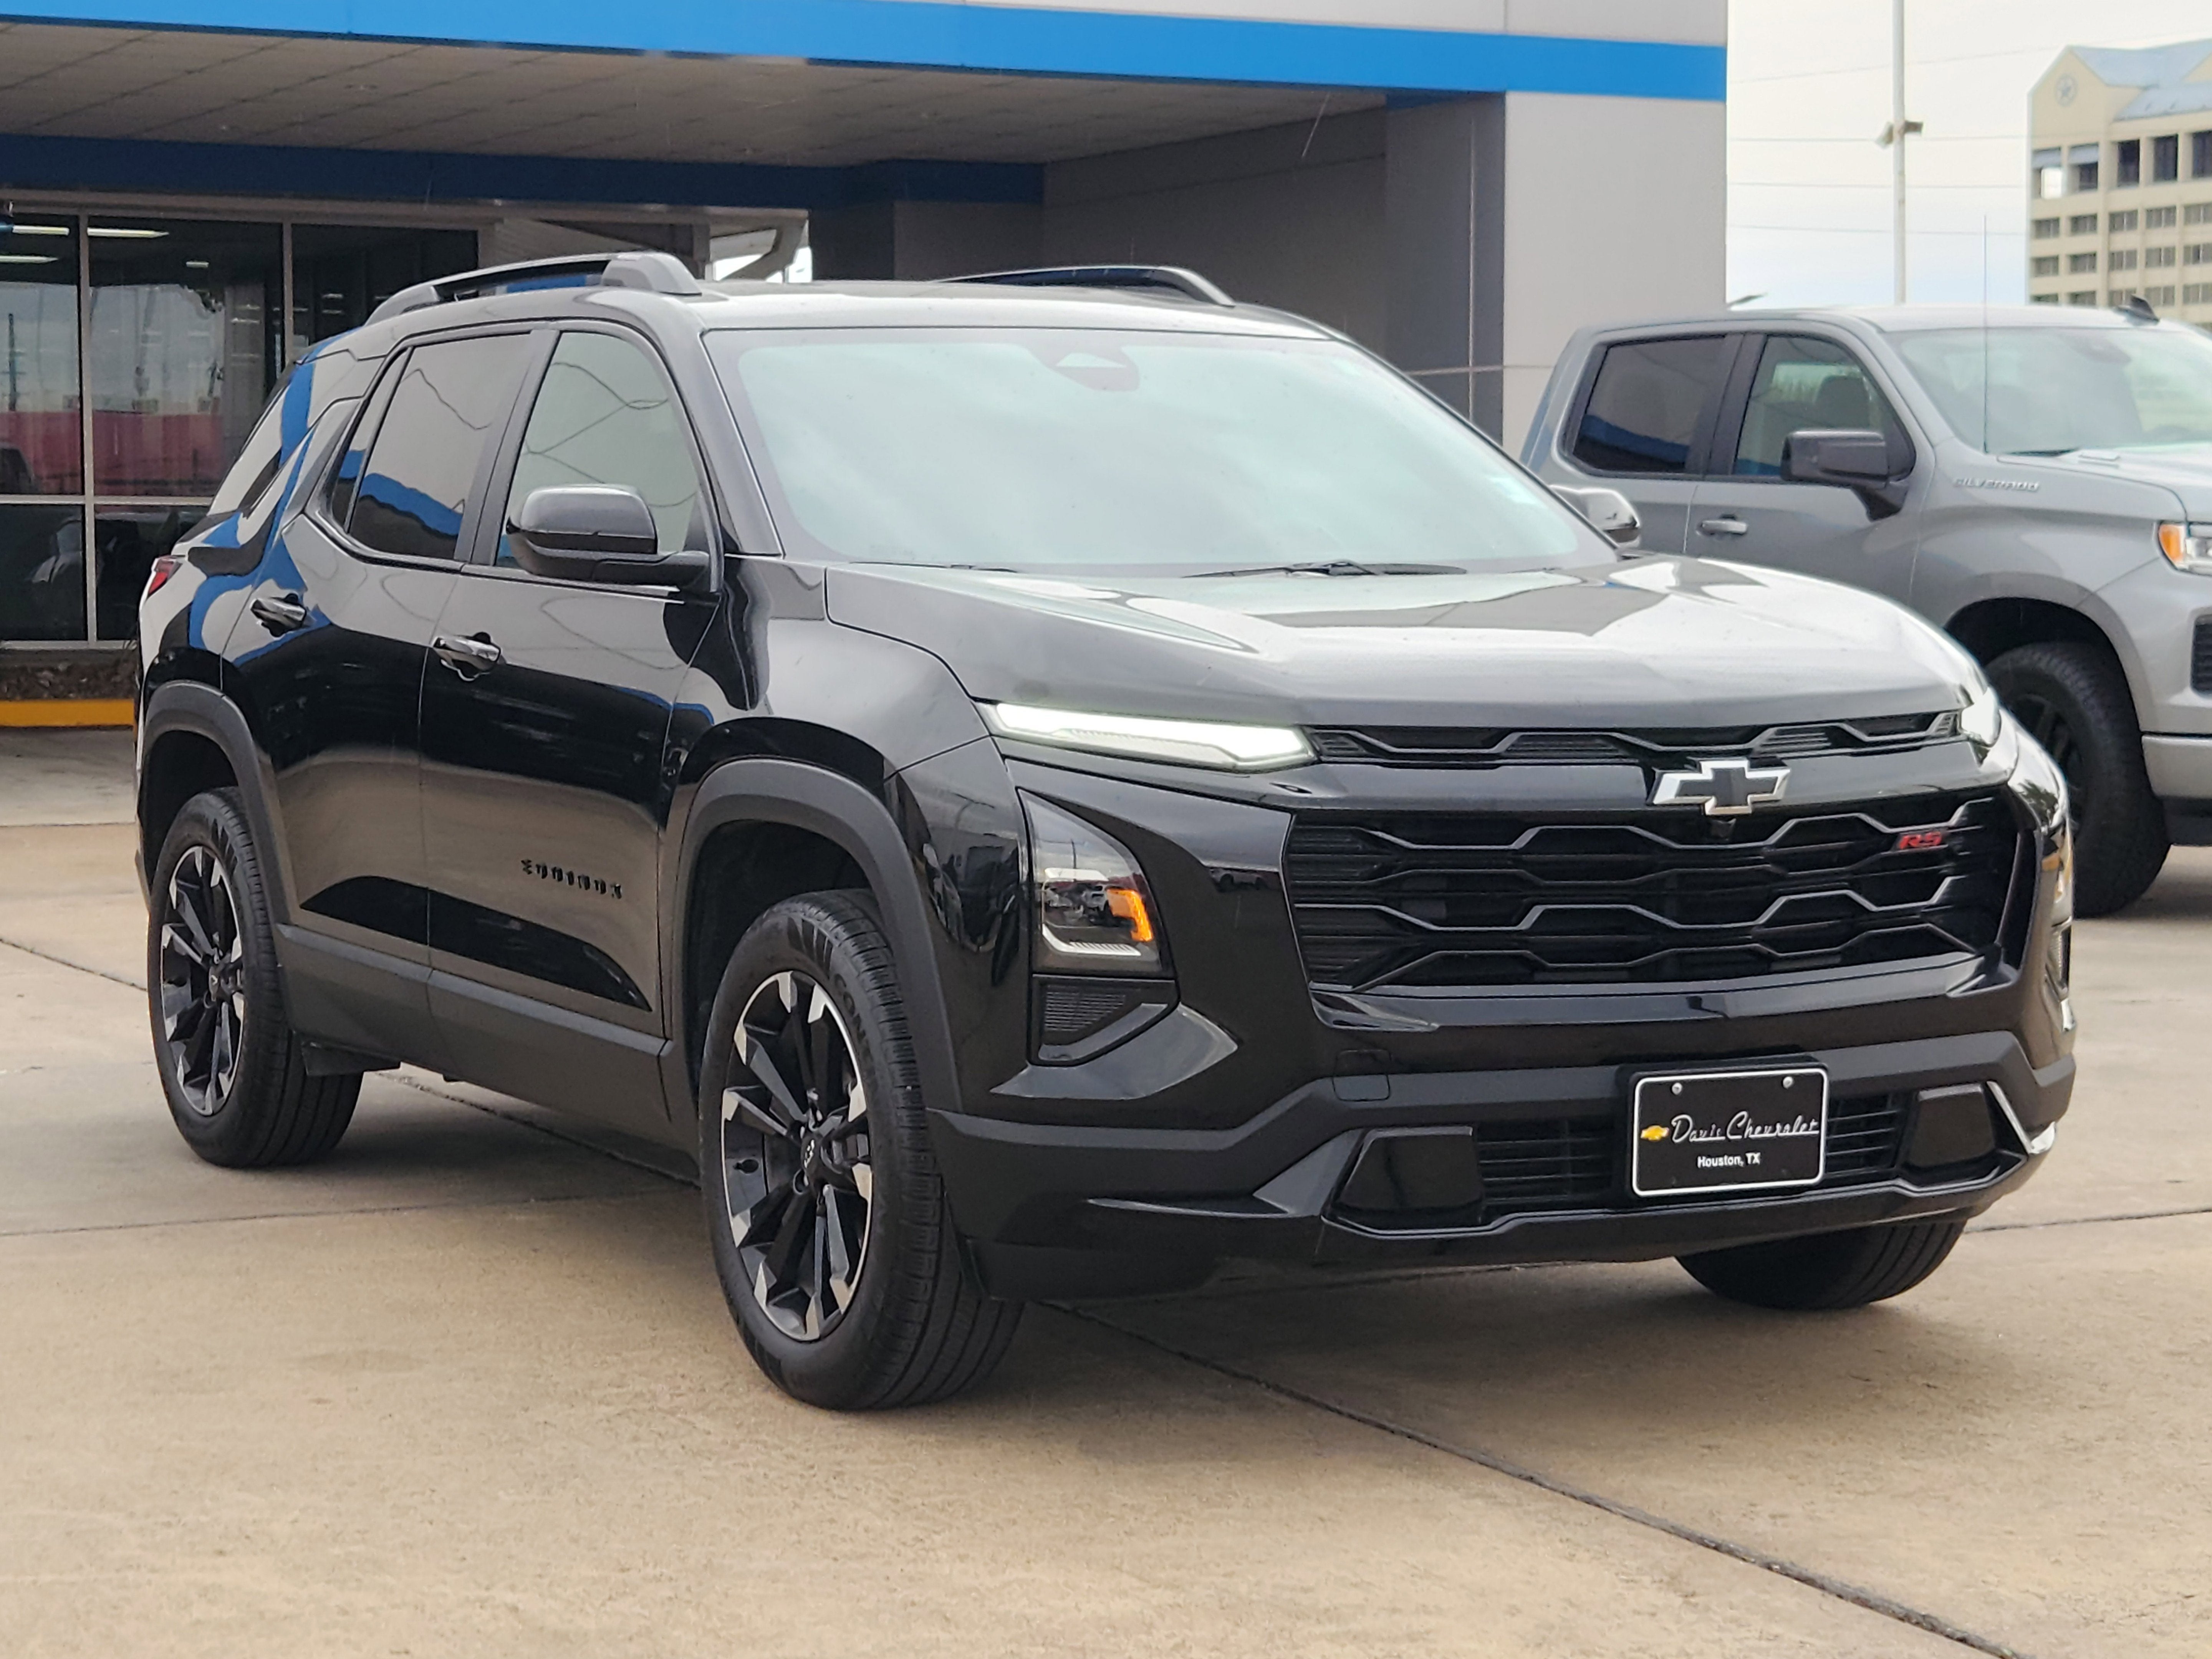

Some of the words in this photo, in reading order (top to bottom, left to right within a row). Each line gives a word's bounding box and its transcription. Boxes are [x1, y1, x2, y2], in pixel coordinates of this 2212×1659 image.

[1899, 831, 1942, 849] RS
[1671, 1114, 1726, 1143] Davis
[1727, 1111, 1820, 1139] Chevrolet
[1697, 1155, 1744, 1168] Houston,
[1745, 1152, 1761, 1165] TX
